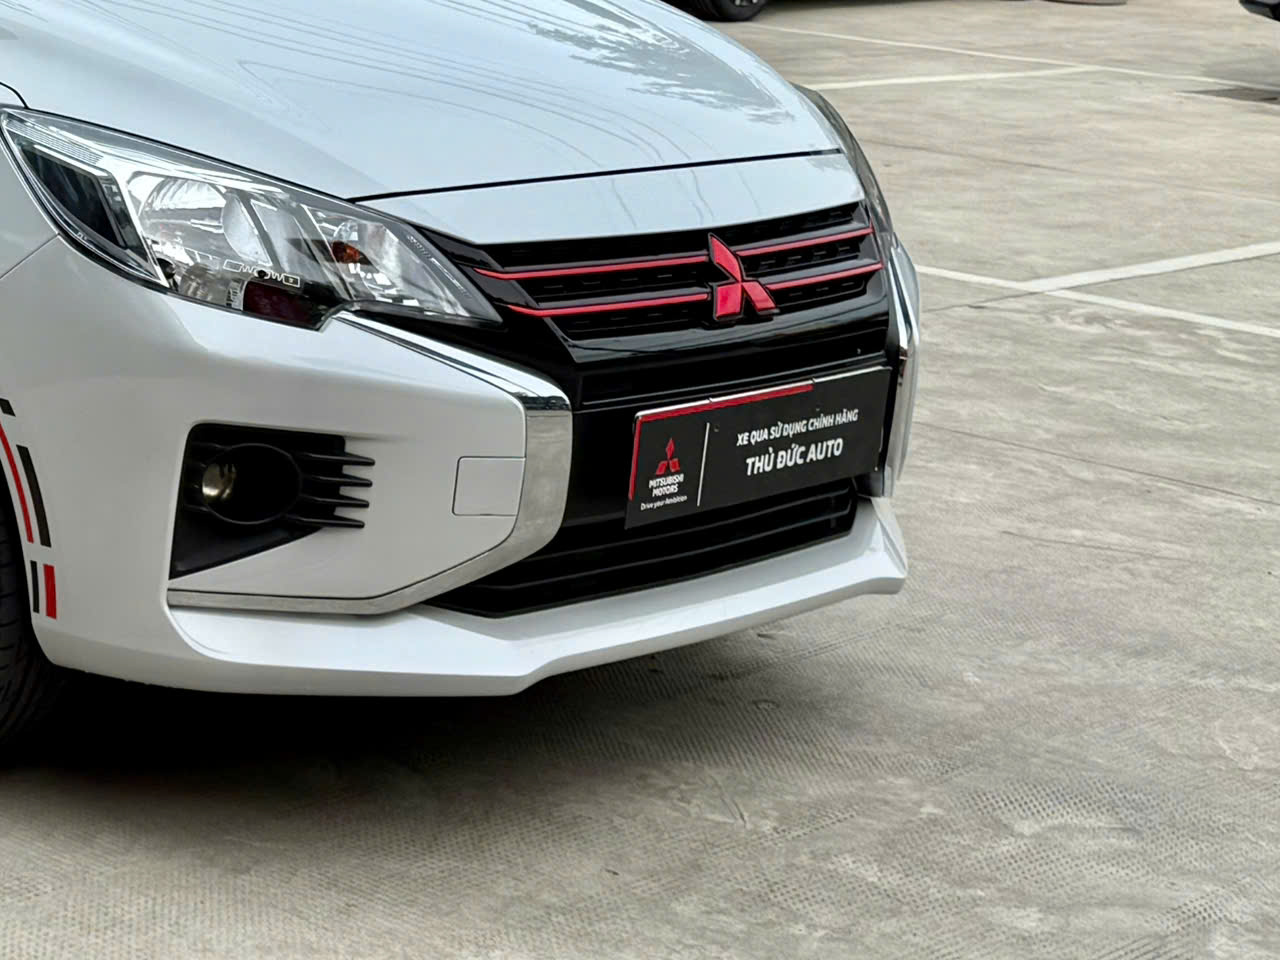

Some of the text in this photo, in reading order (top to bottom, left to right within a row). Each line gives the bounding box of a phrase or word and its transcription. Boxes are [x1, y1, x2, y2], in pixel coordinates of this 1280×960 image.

[736, 409, 858, 446] XE QUA SỬ DỤNG CHÍNH HÃNG
[746, 438, 843, 476] THỦ ĐỨC AUTO
[652, 484, 679, 497] MOTORS
